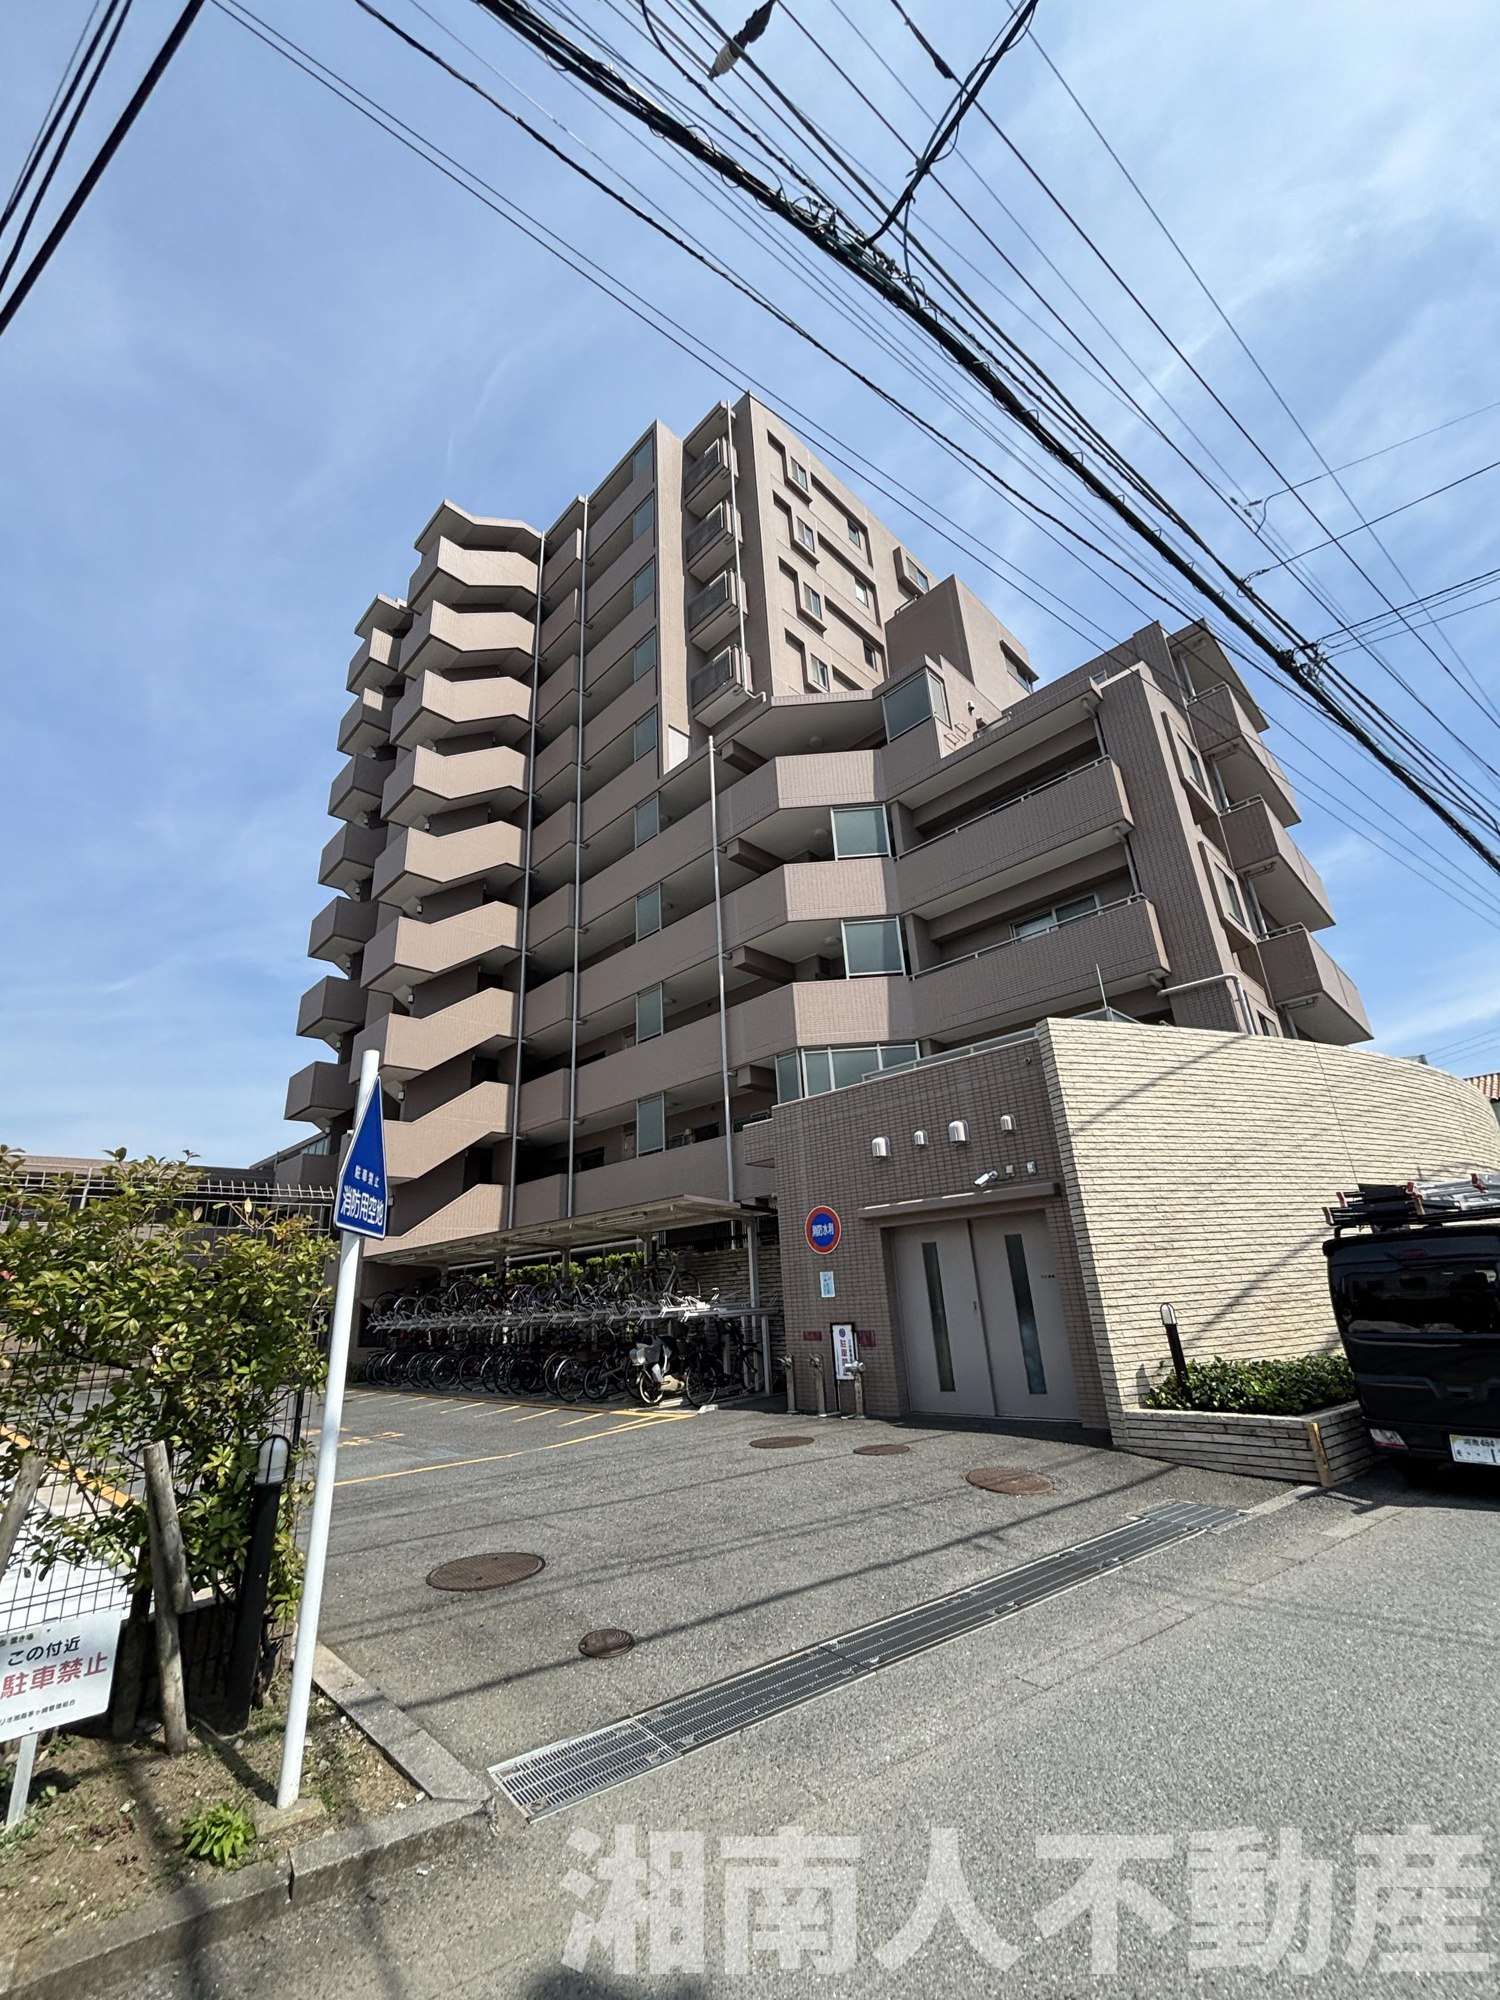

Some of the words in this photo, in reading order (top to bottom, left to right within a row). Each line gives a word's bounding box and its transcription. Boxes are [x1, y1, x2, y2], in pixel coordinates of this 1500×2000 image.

[340, 1185, 384, 1227] 消防用空地
[8, 1635, 81, 1667] この付近
[0, 1651, 109, 1700] 駐車禁止
